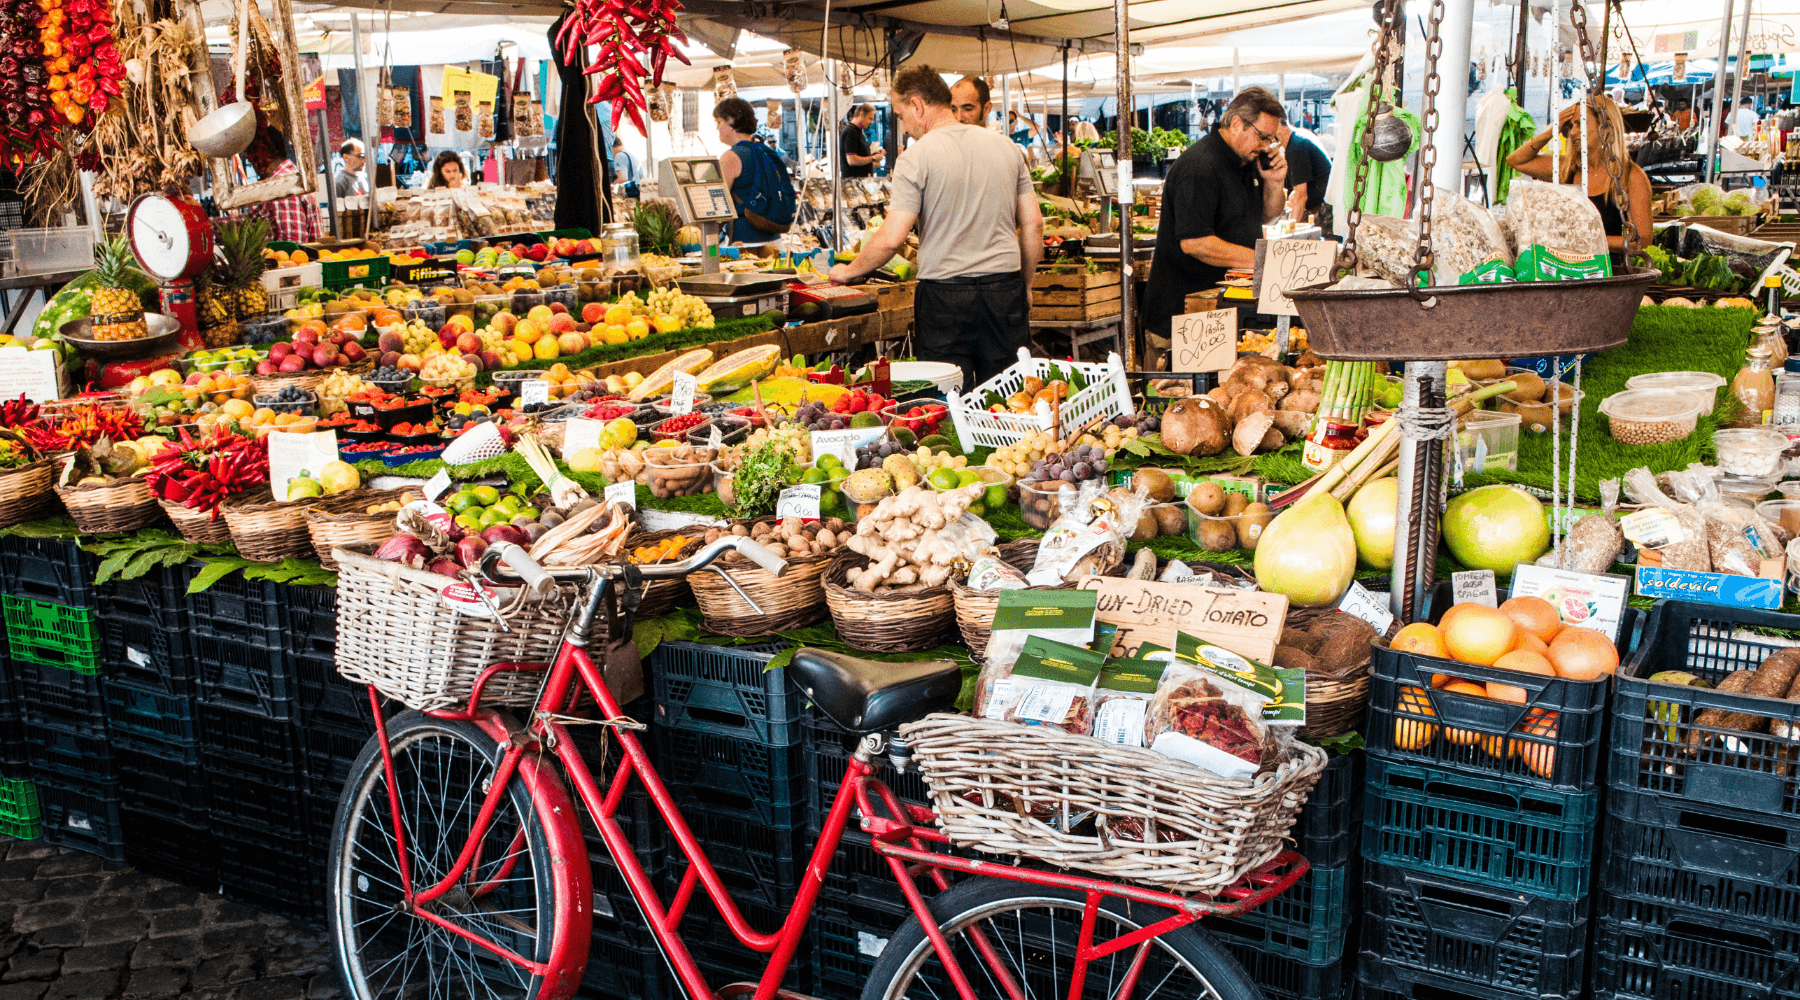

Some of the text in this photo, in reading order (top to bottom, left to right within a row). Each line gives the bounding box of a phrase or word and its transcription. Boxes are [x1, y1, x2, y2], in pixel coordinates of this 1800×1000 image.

[816, 434, 860, 444] Avocado
[1646, 577, 1719, 594] soldevila
[1262, 708, 1281, 717] tempi
